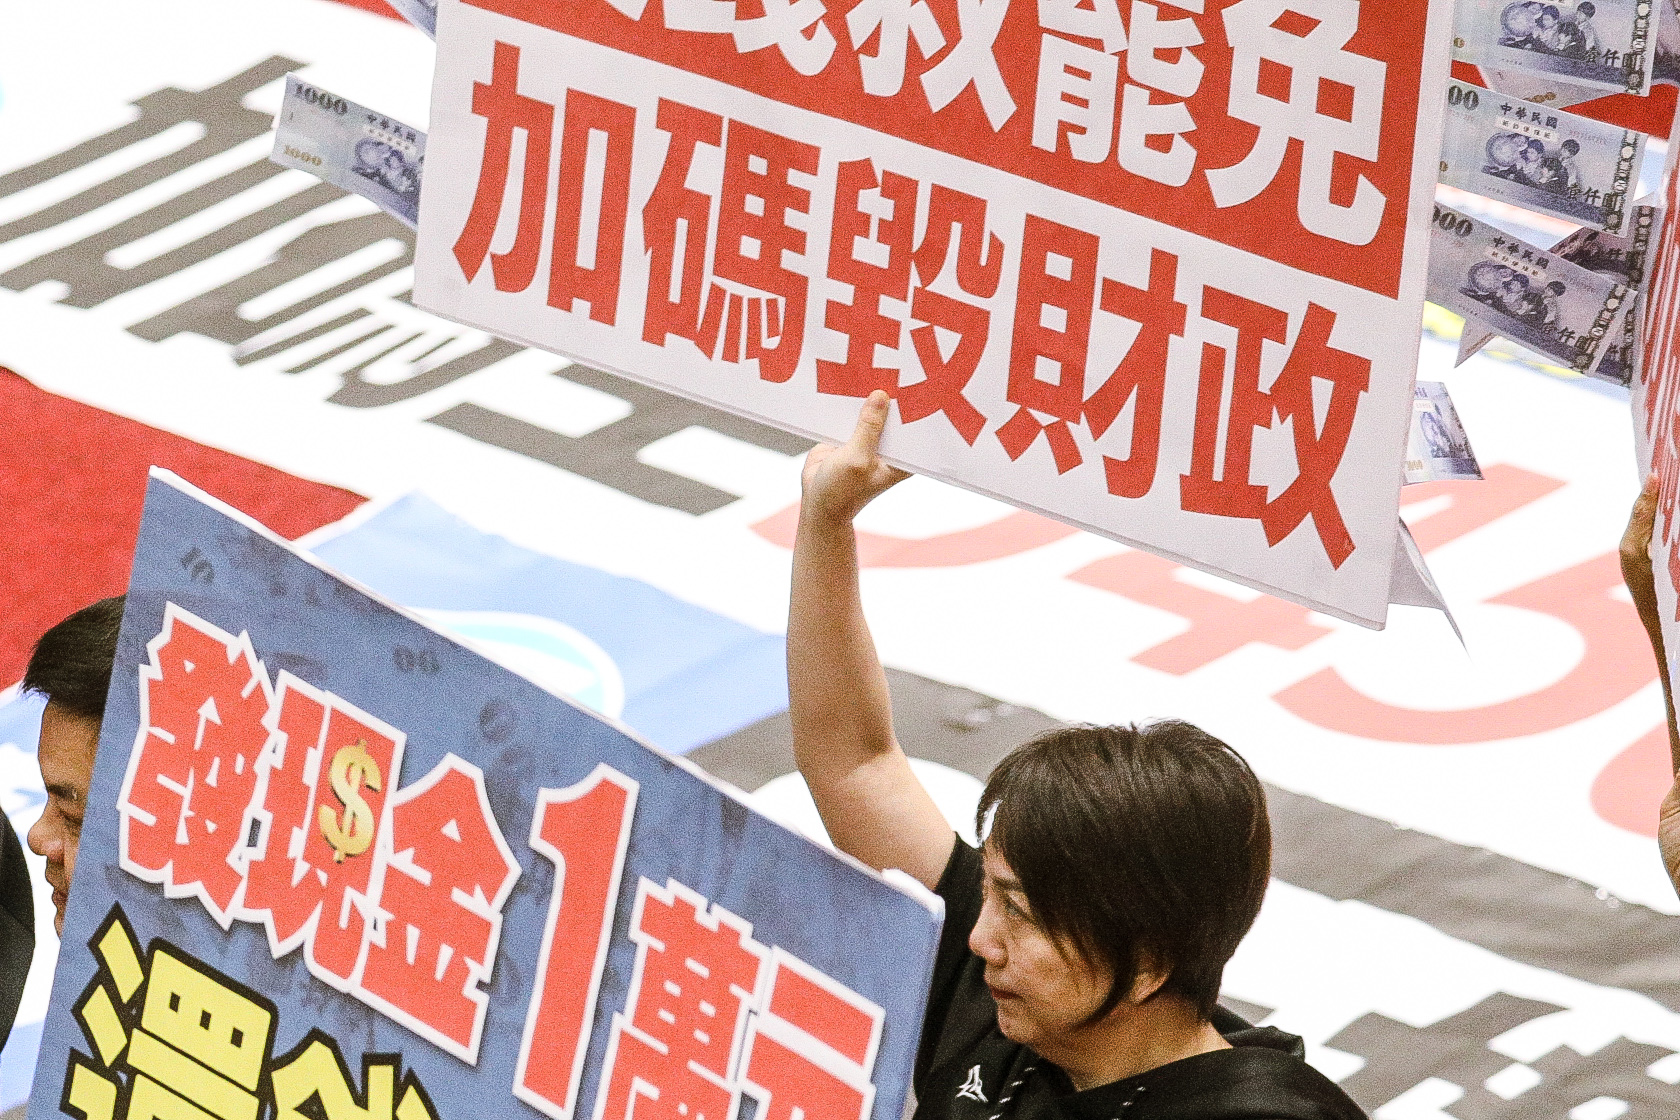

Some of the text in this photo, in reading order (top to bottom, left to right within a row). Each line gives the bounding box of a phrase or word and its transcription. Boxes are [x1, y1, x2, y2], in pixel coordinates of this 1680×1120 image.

[452, 40, 1372, 571] 加碼毀財政
